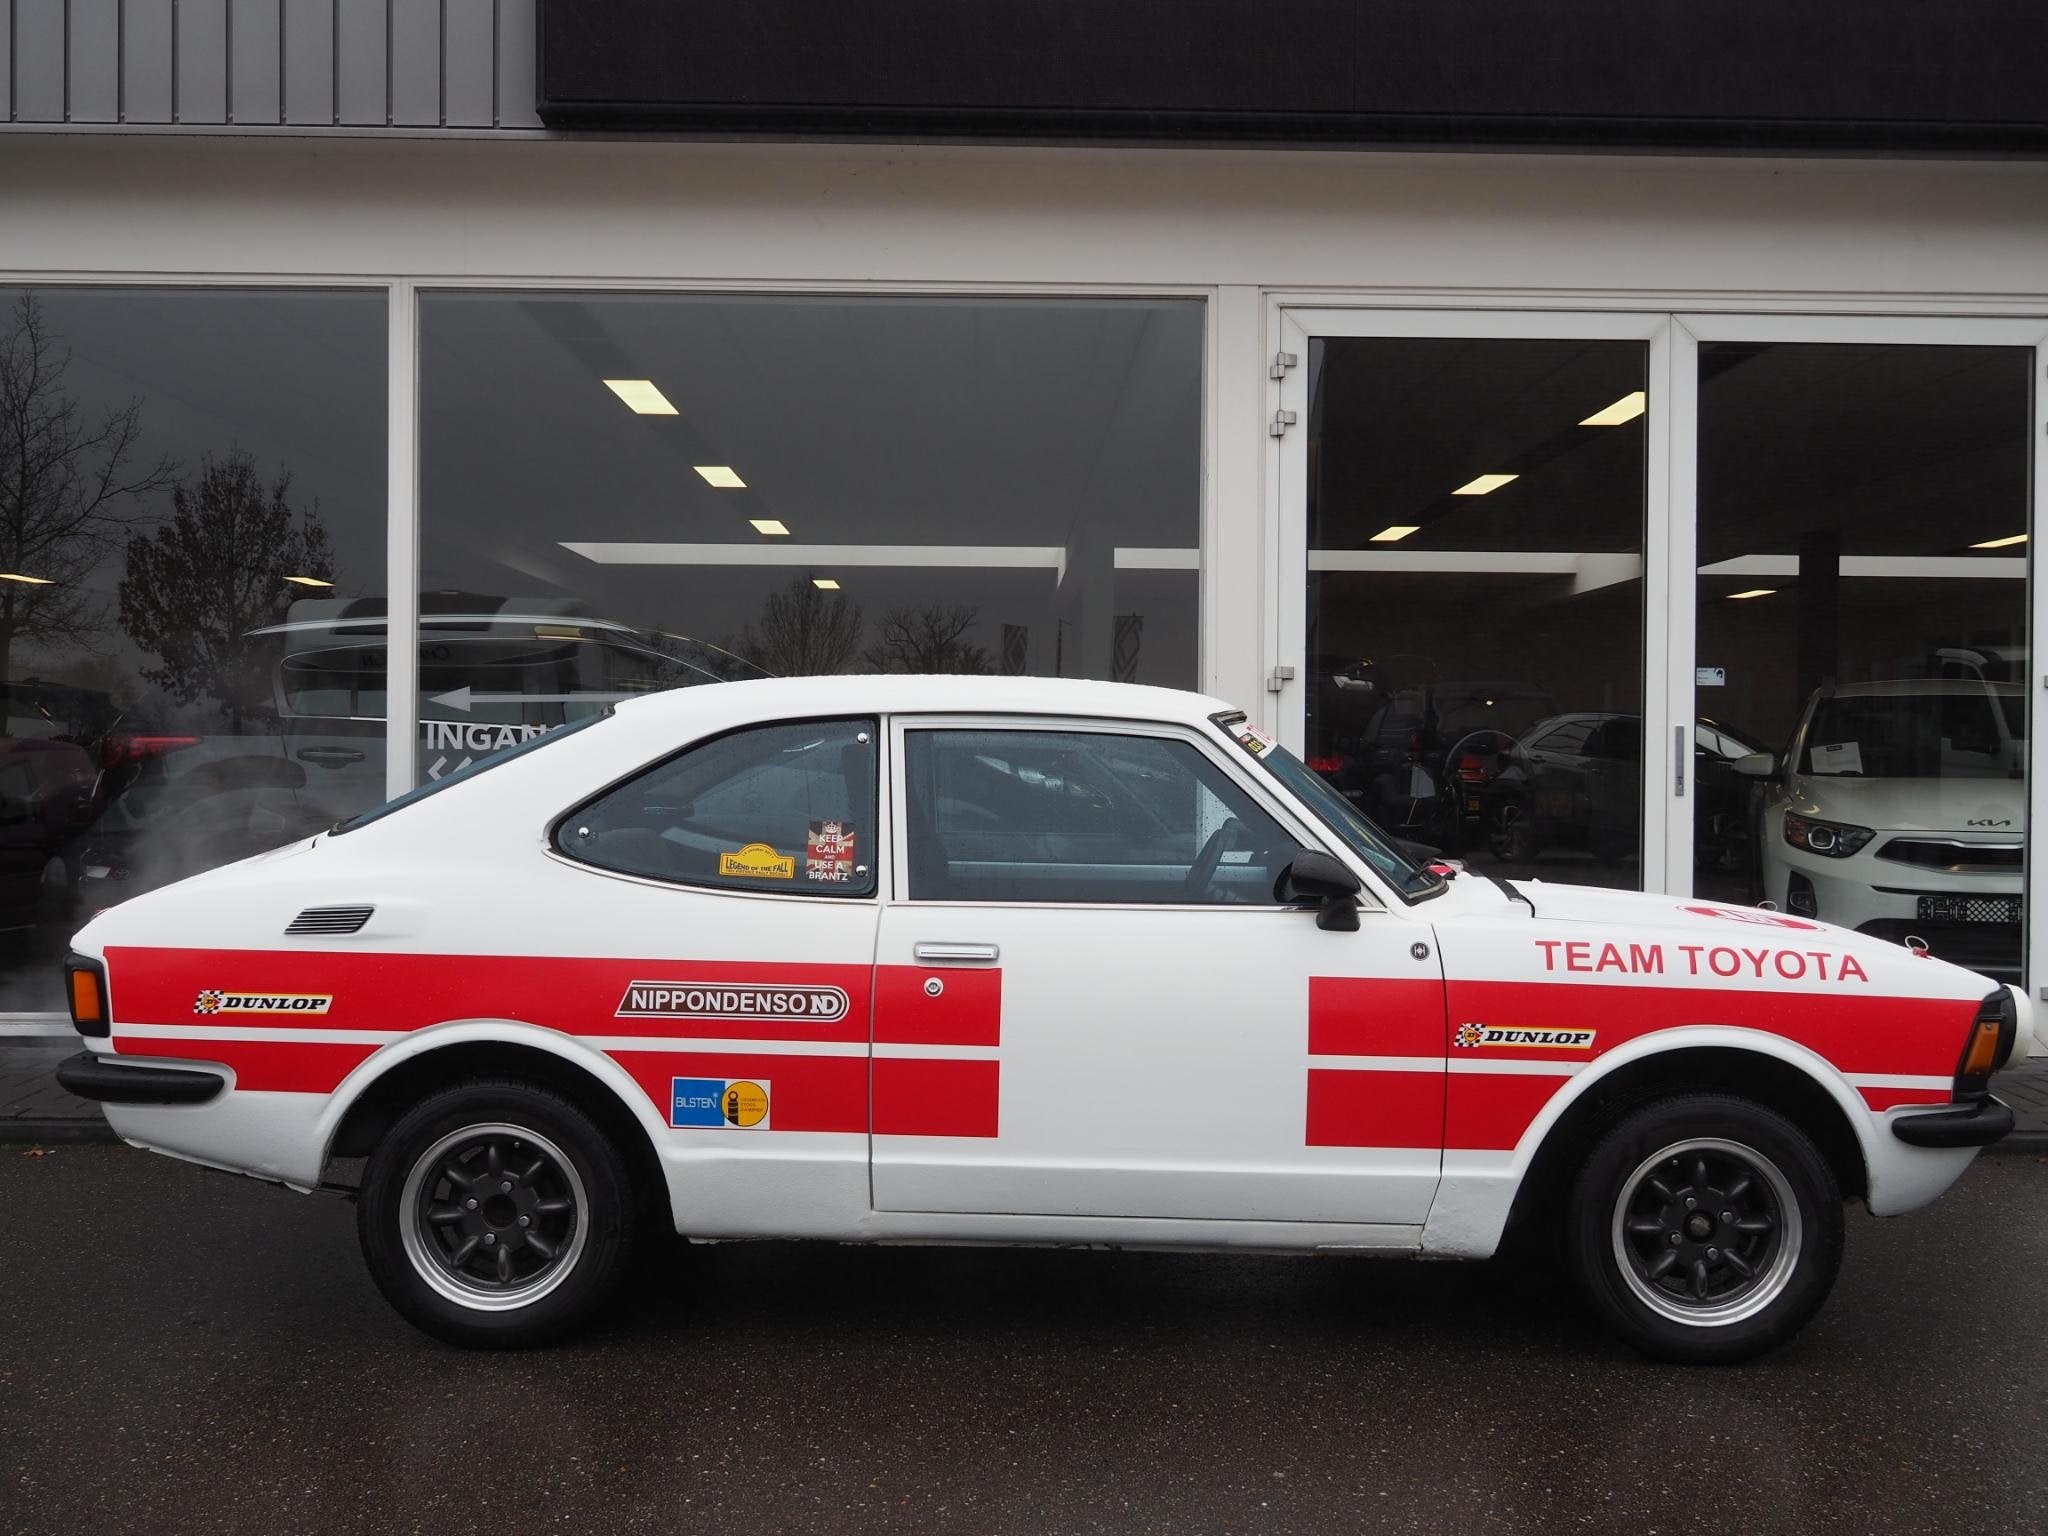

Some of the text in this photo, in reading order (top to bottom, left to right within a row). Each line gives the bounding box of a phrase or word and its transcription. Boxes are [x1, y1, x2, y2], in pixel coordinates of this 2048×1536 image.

[427, 723, 565, 750] INGAN
[820, 834, 843, 843] KEEP
[816, 845, 845, 854] CALM
[726, 857, 750, 871] LEGEND
[773, 861, 788, 873] FALL
[815, 860, 833, 869] USE
[809, 872, 848, 881] BRANTZ
[1535, 940, 1869, 982] TEAM TOYOTA
[223, 997, 327, 1010] DUNLOP
[631, 990, 806, 1013] NIPPONDENSO
[1485, 1030, 1590, 1044] DUNLOP
